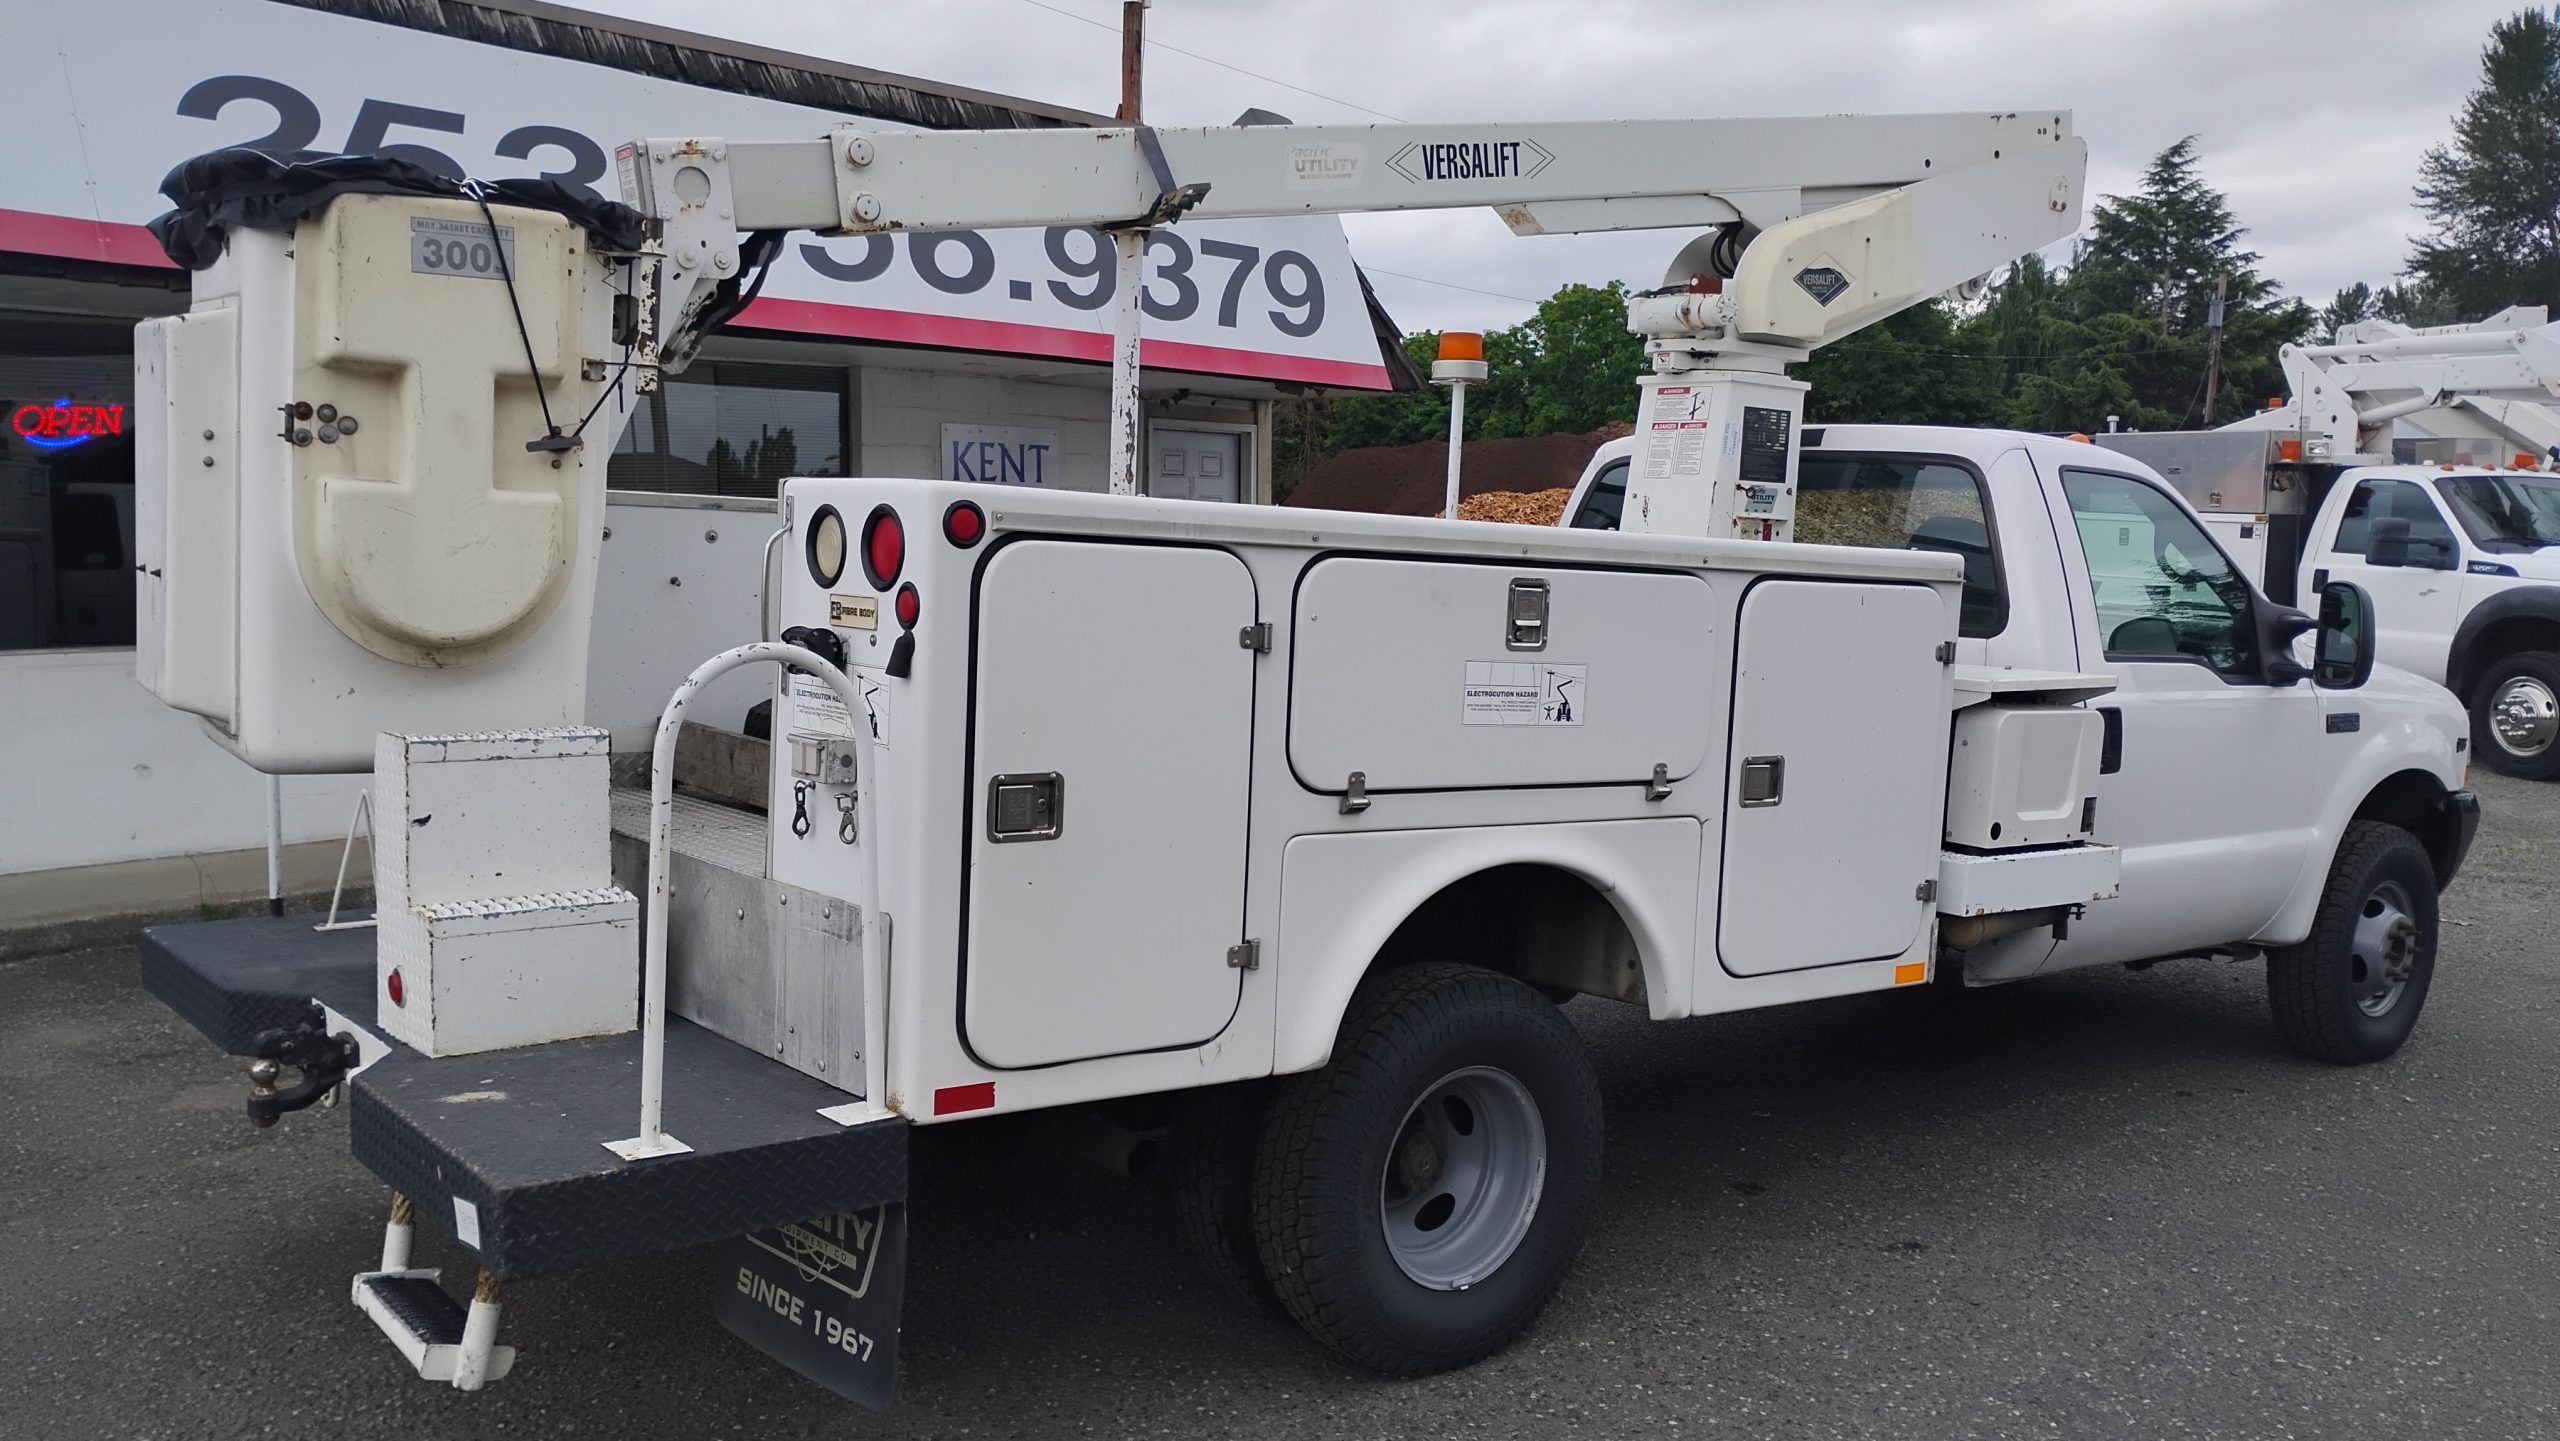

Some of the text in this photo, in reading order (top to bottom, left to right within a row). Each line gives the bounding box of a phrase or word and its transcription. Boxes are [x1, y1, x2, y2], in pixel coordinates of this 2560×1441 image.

[1294, 159, 1358, 172] UTILITY
[1421, 142, 1520, 180] VERSALIFT
[471, 226, 509, 236] CAPAITY
[422, 239, 491, 273] 300
[1803, 274, 1836, 285] VERSALIFT
[13, 405, 123, 435] OPEN
[952, 441, 1050, 483] KENT
[859, 607, 875, 618] BODY
[1466, 690, 1515, 698] ELECTROCUTION
[736, 1266, 874, 1362] SINCE 1967
